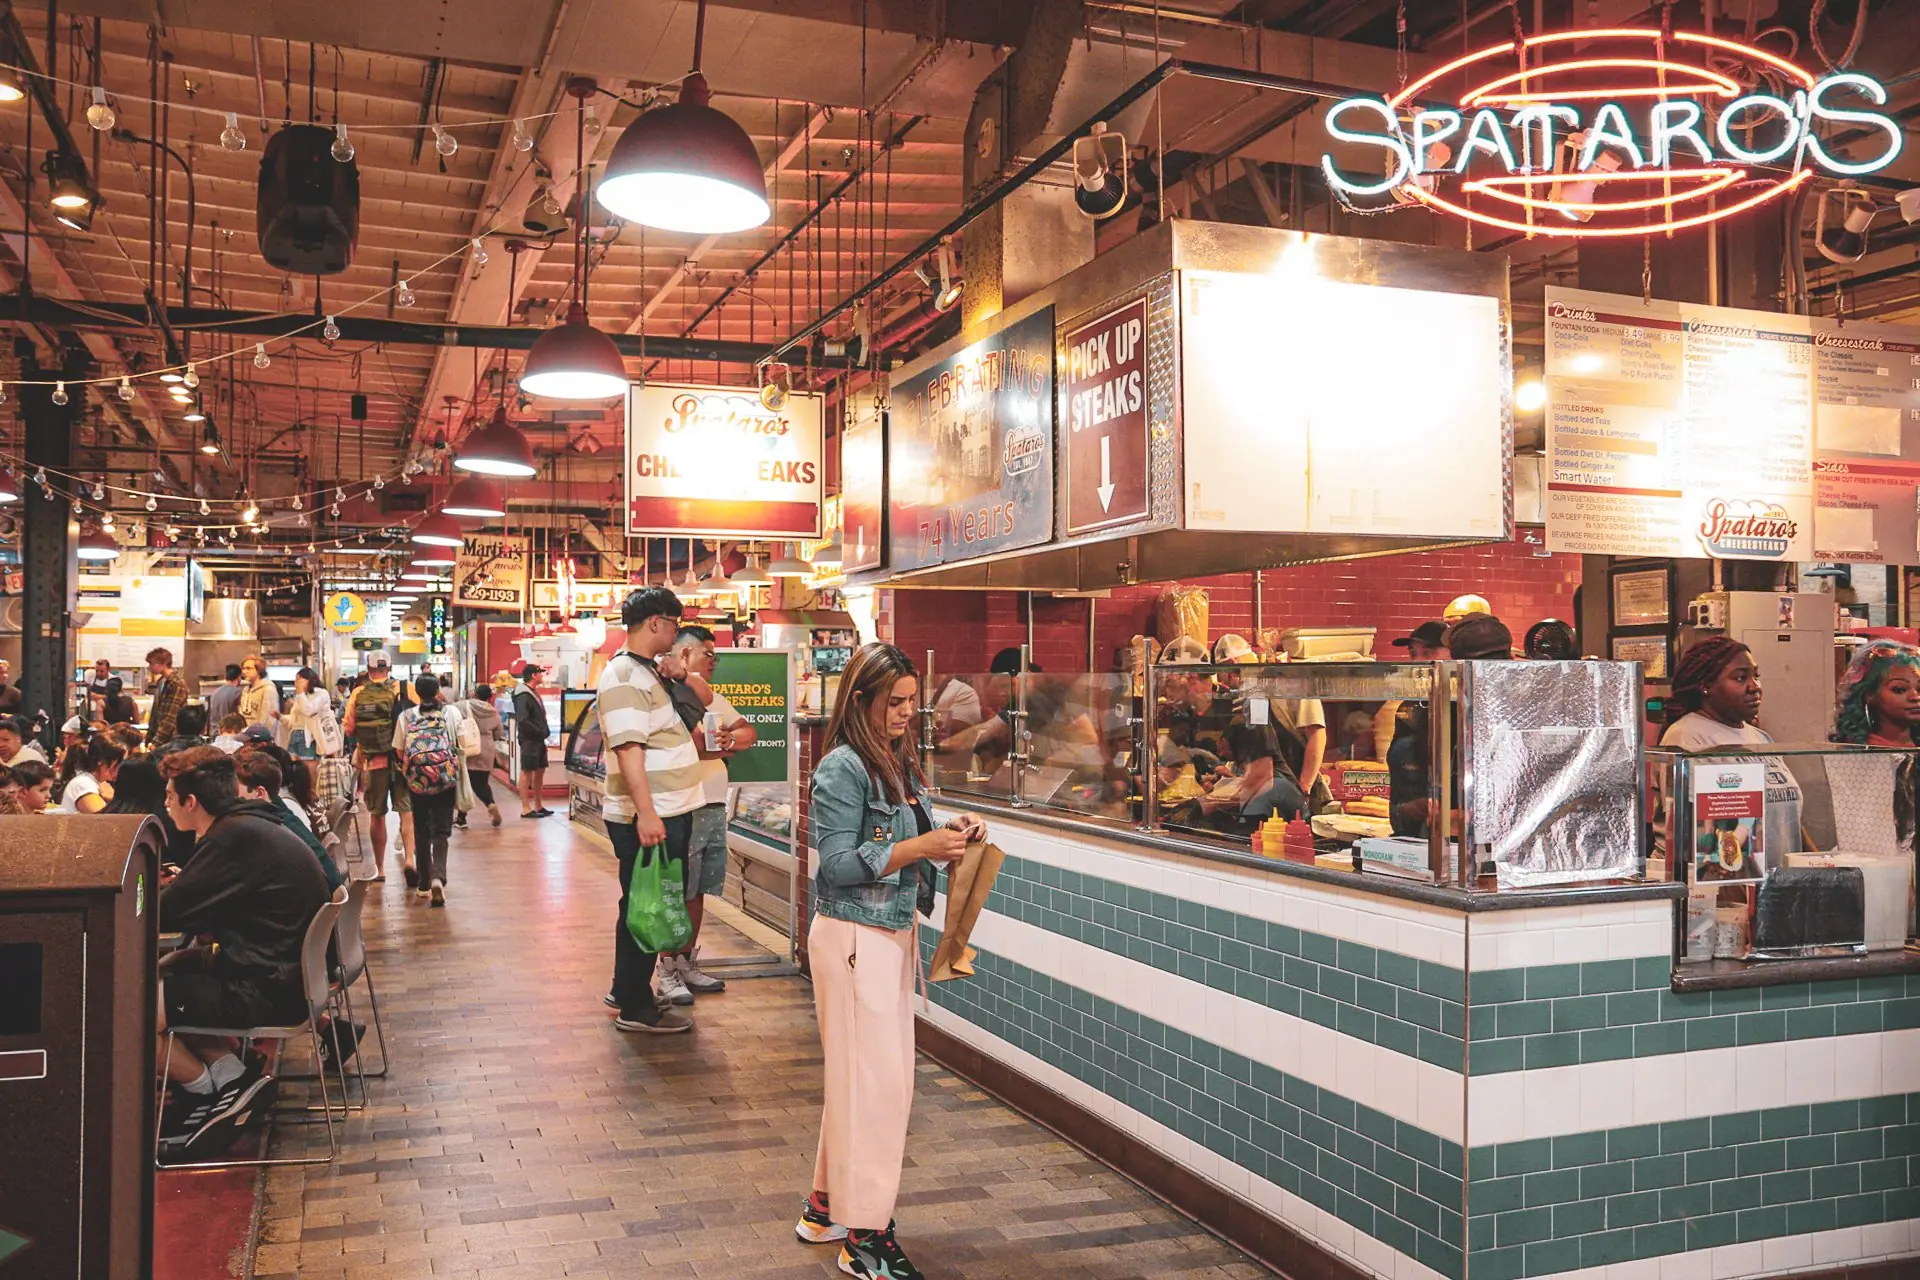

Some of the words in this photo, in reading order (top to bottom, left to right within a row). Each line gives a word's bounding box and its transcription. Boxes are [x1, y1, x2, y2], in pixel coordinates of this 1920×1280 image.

[1322, 72, 1902, 196] SPATARO'S
[1551, 301, 1596, 321] Drinks
[1552, 322, 1582, 332] FOUNTAIN
[1583, 325, 1600, 334] SODA
[1554, 330, 1588, 341] Coca-Cola
[1815, 332, 1885, 350] Cheesesteak
[1070, 331, 1111, 384] PICK
[1115, 318, 1141, 365] UP
[1071, 370, 1141, 433] STEAKS
[1581, 406, 1604, 414] DRINKS
[1554, 414, 1578, 422] Bottled
[1554, 426, 1578, 434] Bottled
[1554, 448, 1578, 456] Bottled
[1554, 460, 1578, 468] Bottled
[1817, 458, 1849, 473] Sides
[1554, 470, 1582, 482] Smart
[1701, 503, 1798, 543] Spataro's
[920, 519, 942, 561] 74
[950, 501, 1014, 546] Years
[1720, 540, 1785, 551] CHEESESTEAKS
[758, 740, 785, 748] FRONT)
